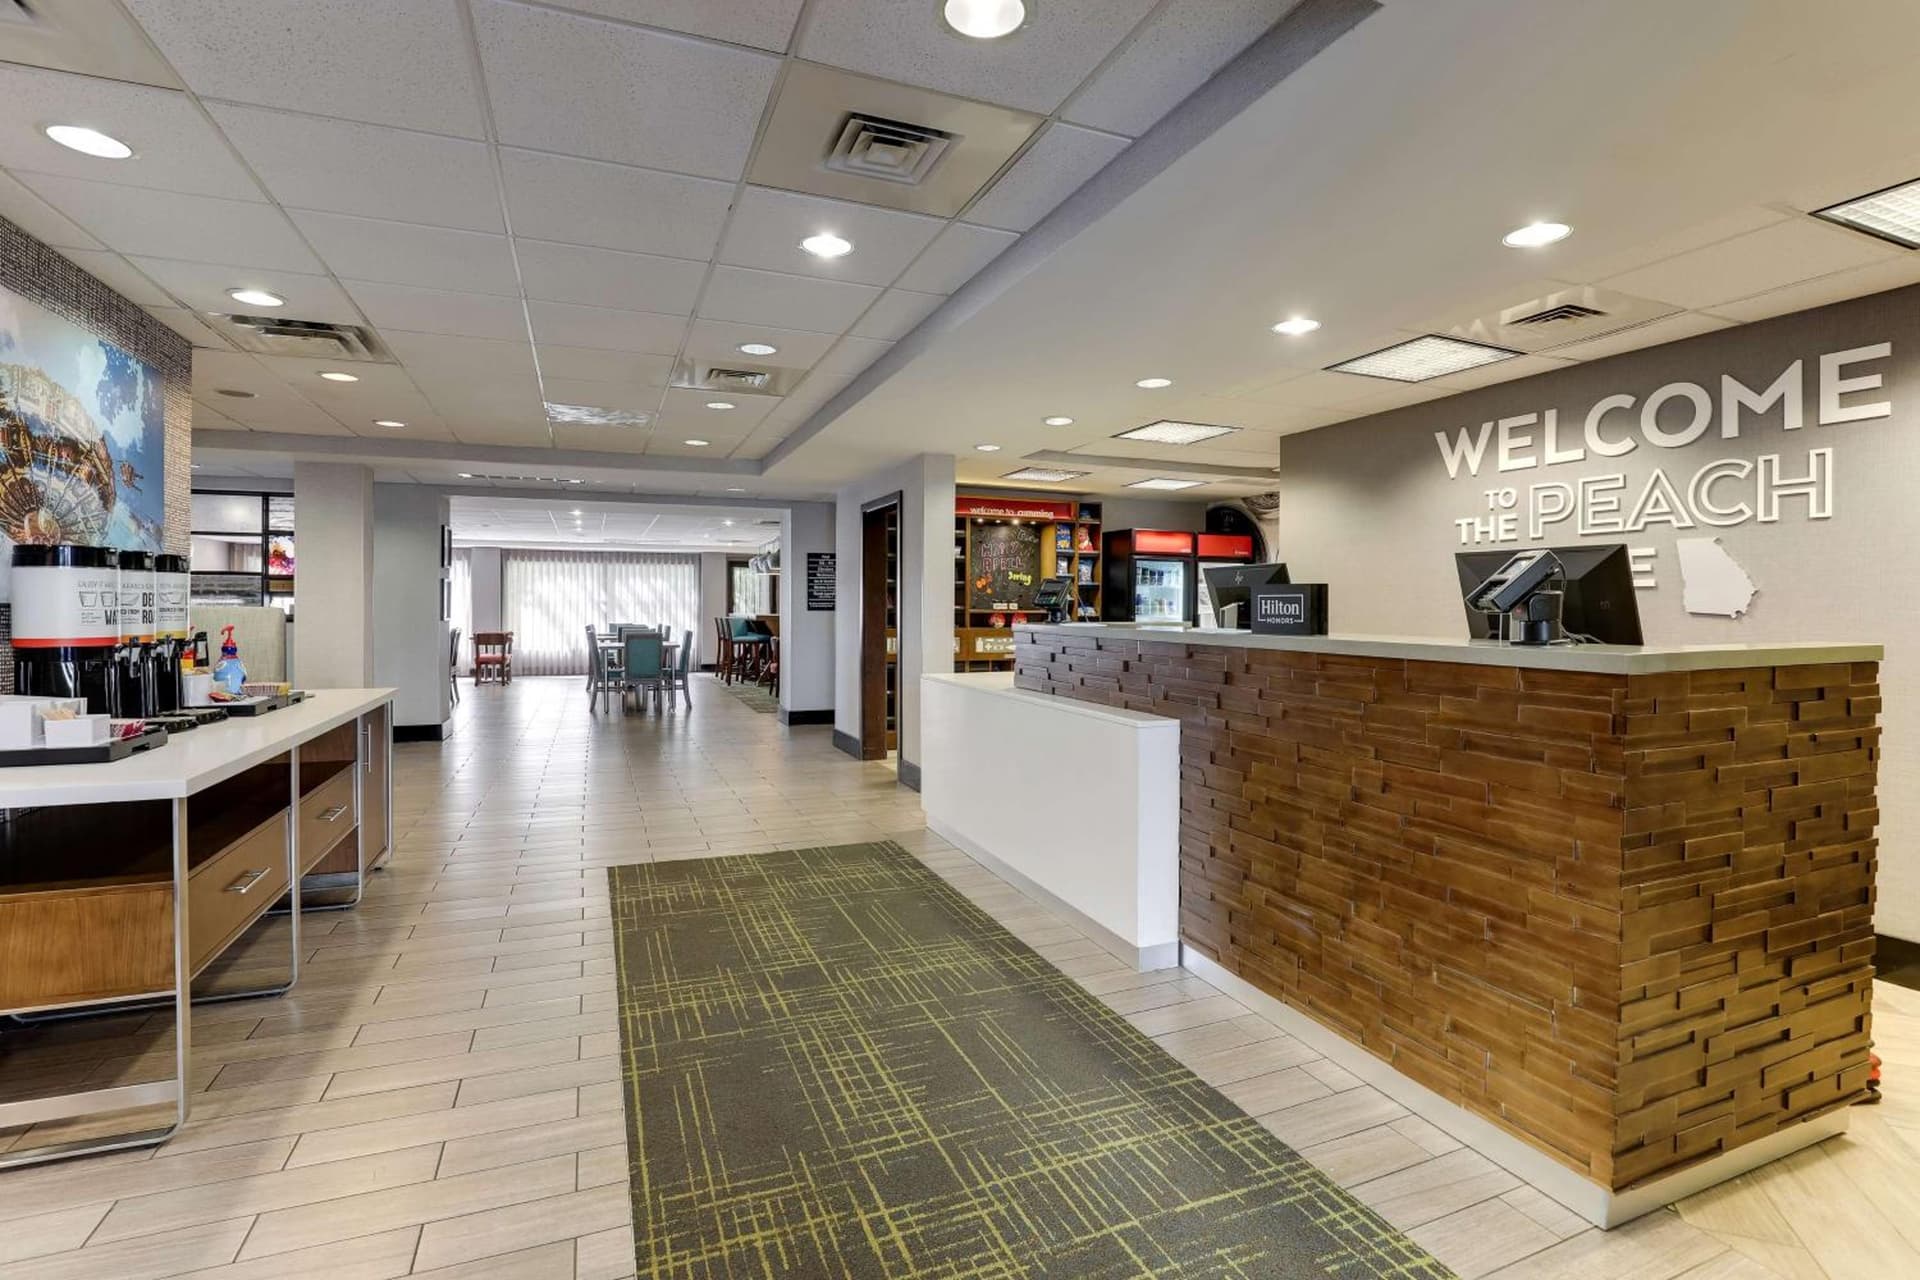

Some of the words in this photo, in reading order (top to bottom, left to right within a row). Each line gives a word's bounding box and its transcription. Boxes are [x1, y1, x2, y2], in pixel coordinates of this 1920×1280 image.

[1434, 342, 1892, 479] WELCOME
[1484, 487, 1518, 511] TO
[1529, 447, 1834, 539] PEACH
[970, 506, 1004, 516] welcome
[1005, 508, 1015, 516] to
[1455, 513, 1519, 545] THE
[1261, 599, 1299, 615] Hilton
[1266, 616, 1294, 624] HONORS
